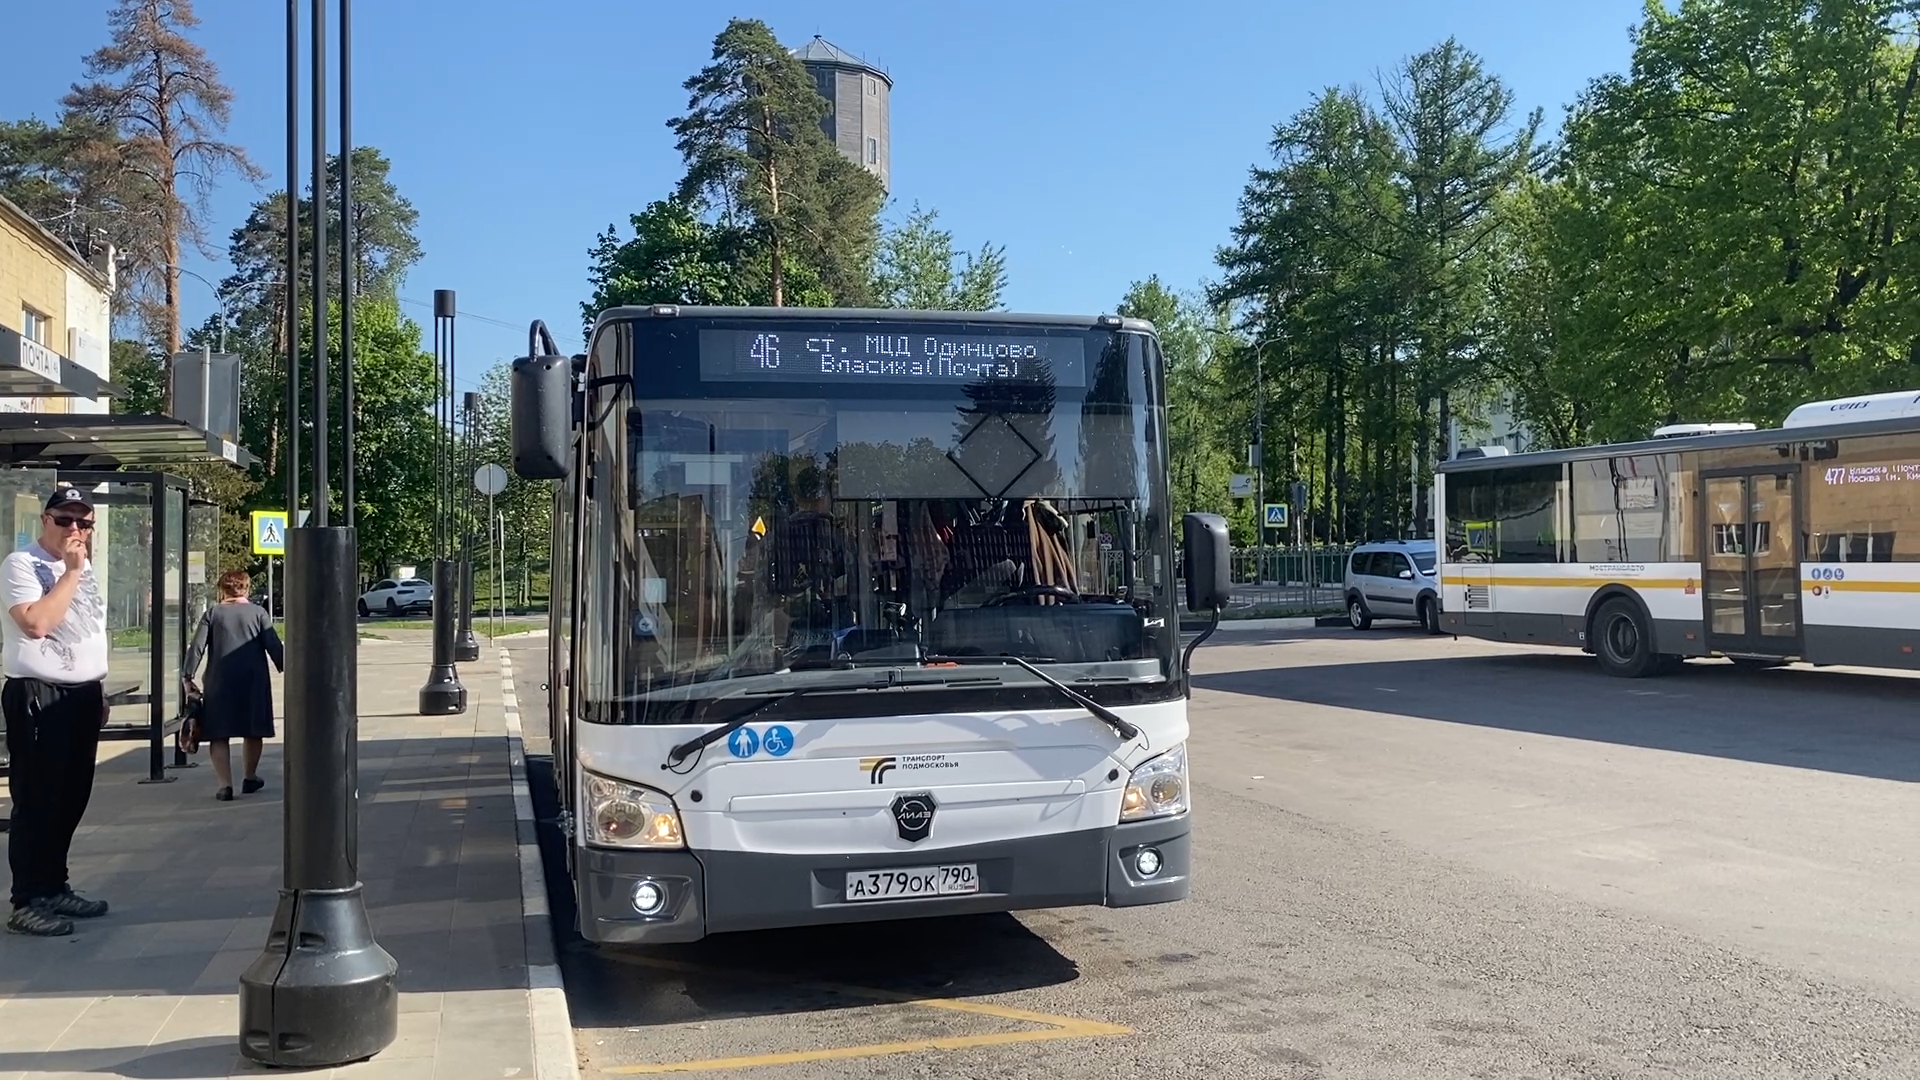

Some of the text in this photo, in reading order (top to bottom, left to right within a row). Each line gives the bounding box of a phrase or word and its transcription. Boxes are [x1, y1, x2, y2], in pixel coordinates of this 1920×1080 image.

[22, 342, 50, 375] ПОЧТА
[750, 334, 781, 369] 46
[806, 335, 1038, 359] ст. МЦД Одинцово
[1825, 467, 1846, 485] 477
[940, 867, 971, 884] 790
